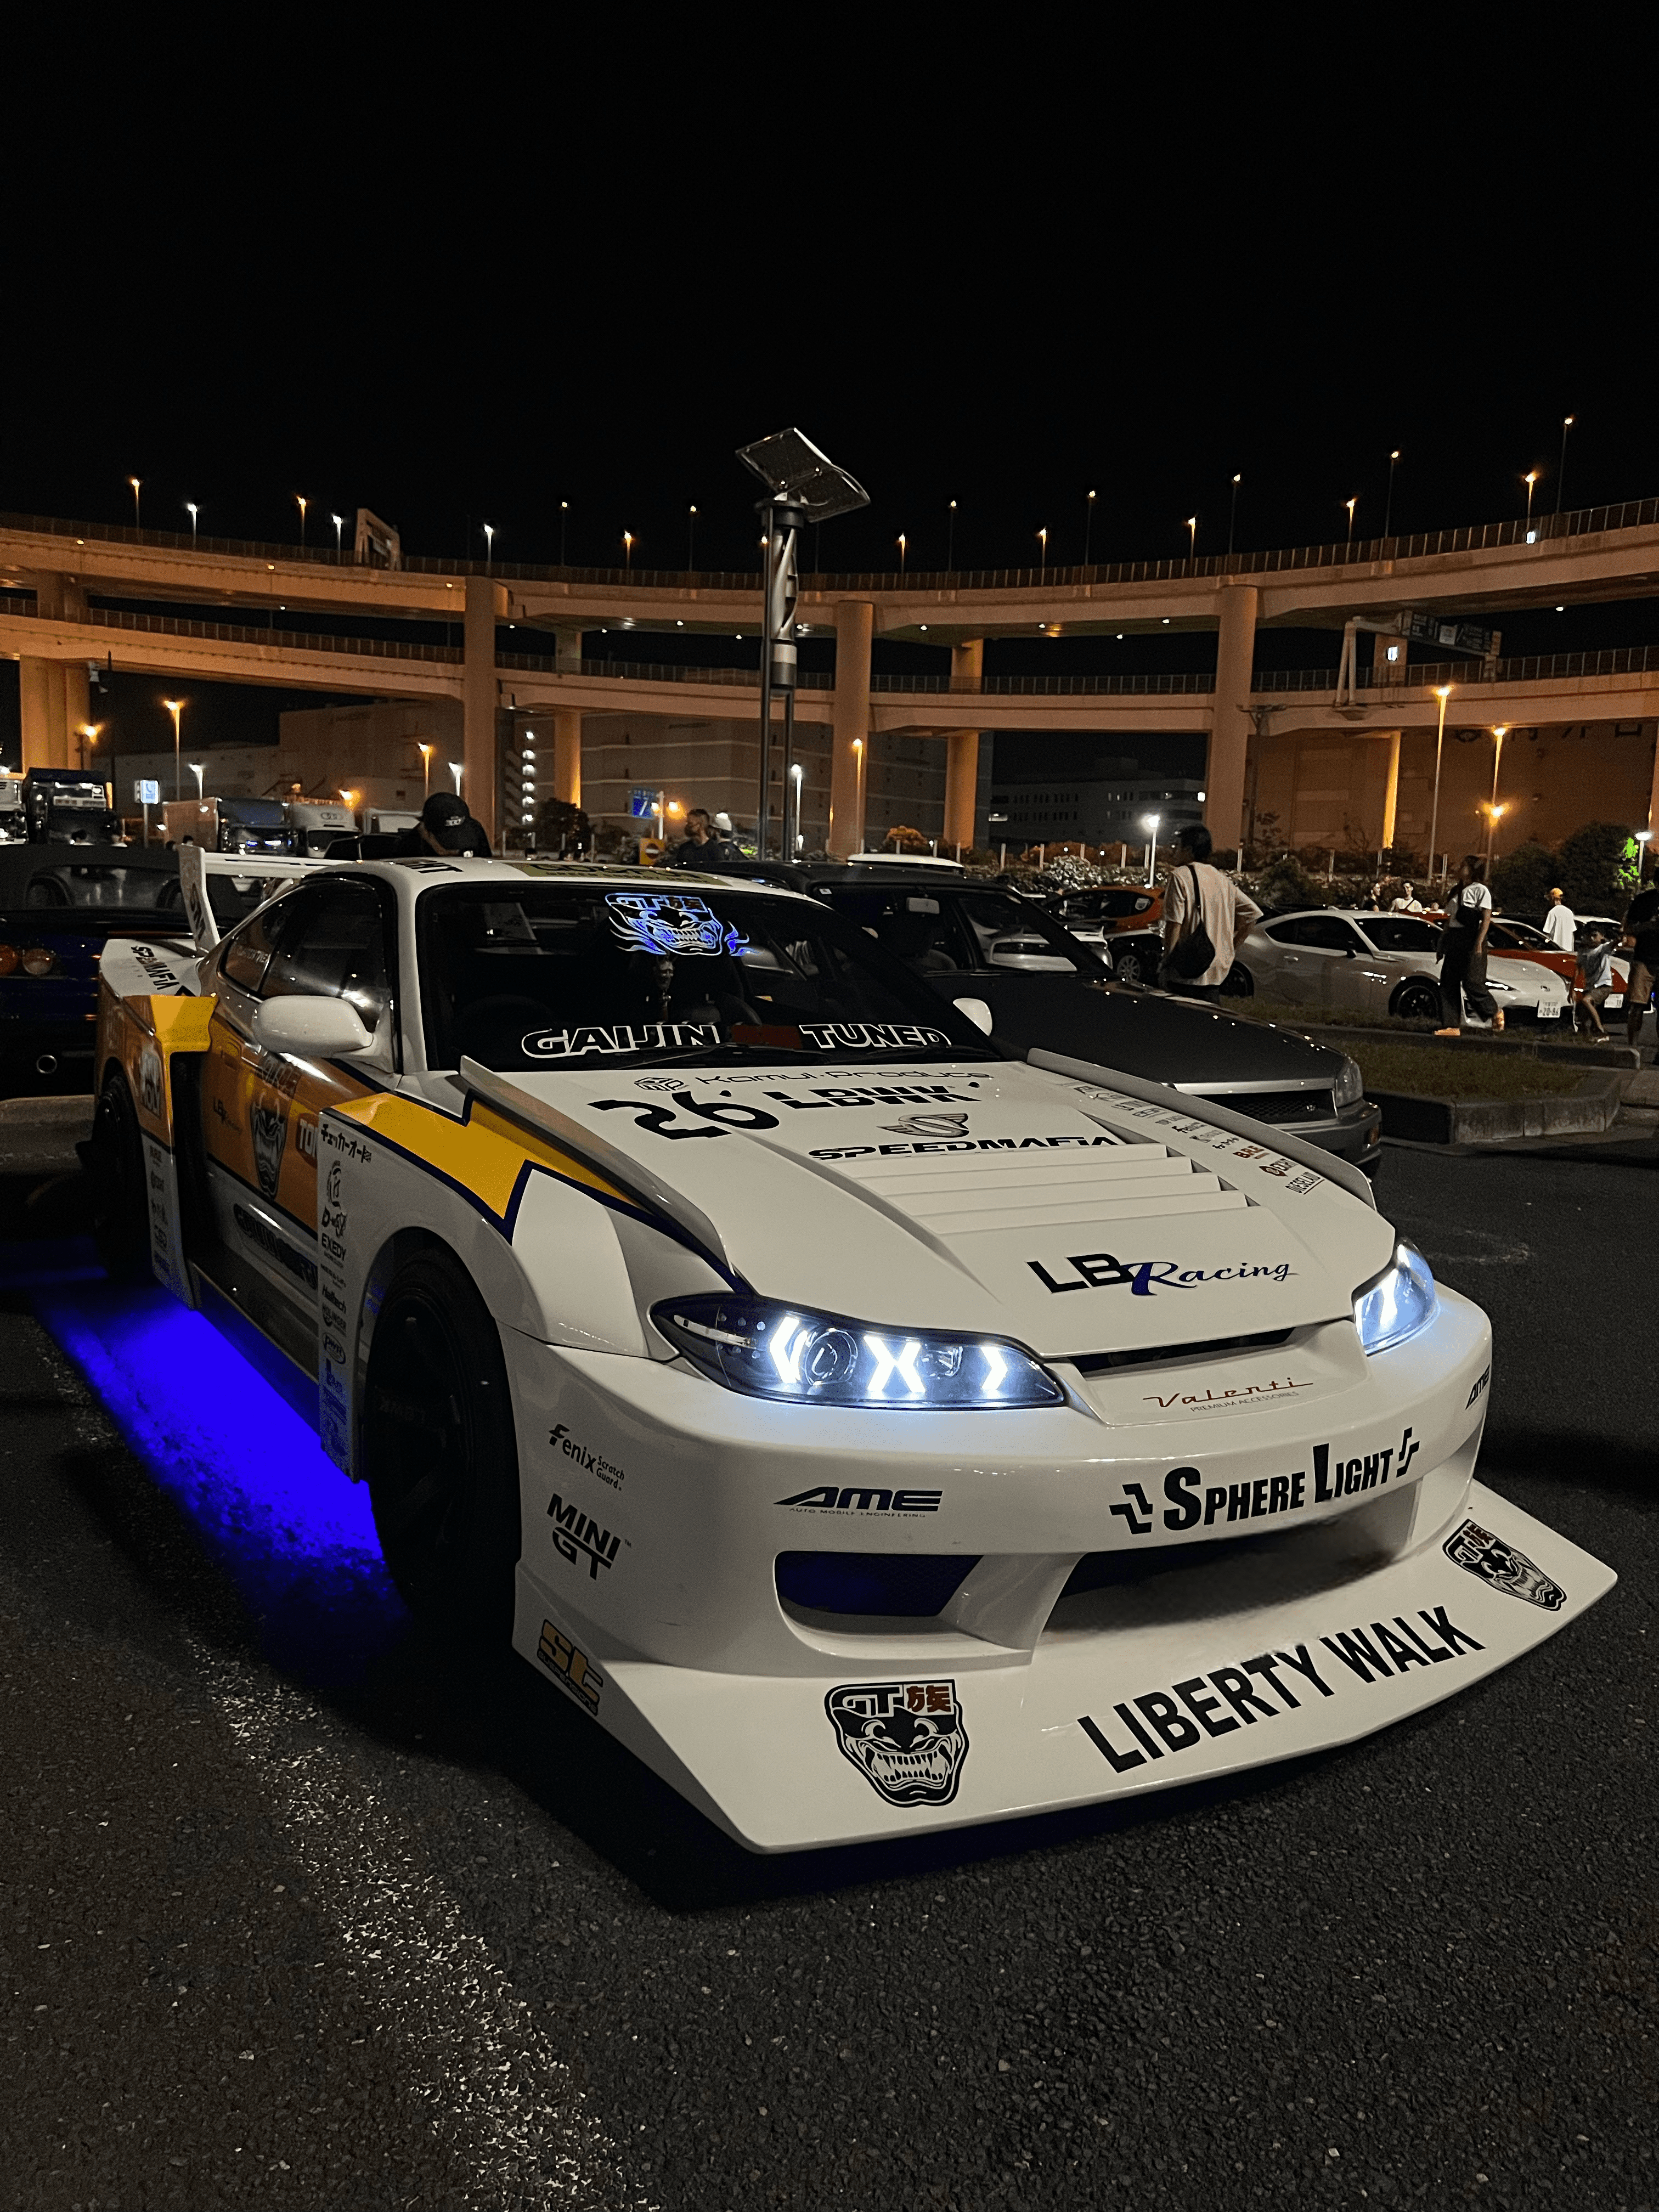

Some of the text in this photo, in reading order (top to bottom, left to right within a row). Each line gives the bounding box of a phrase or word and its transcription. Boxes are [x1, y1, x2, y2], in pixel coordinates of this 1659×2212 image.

[521, 1024, 952, 1059] GAIJIN TUNED
[586, 1090, 780, 1140] 26
[808, 1136, 1118, 1160] SPEEDMAFIA
[321, 1233, 346, 1261] EXEDY
[1143, 1378, 1313, 1408] Valenti
[1190, 1391, 1300, 1412] PREMIUM ACCESSORIES
[549, 1424, 597, 1474] Fenix
[597, 1455, 625, 1480] Scratch
[772, 1486, 943, 1512] AME
[1163, 1443, 1393, 1531] SPHERE LIGHT
[547, 1493, 622, 1562] MINI
[552, 1527, 612, 1581] GT
[1076, 1605, 1486, 1774] LIBERTY WALK
